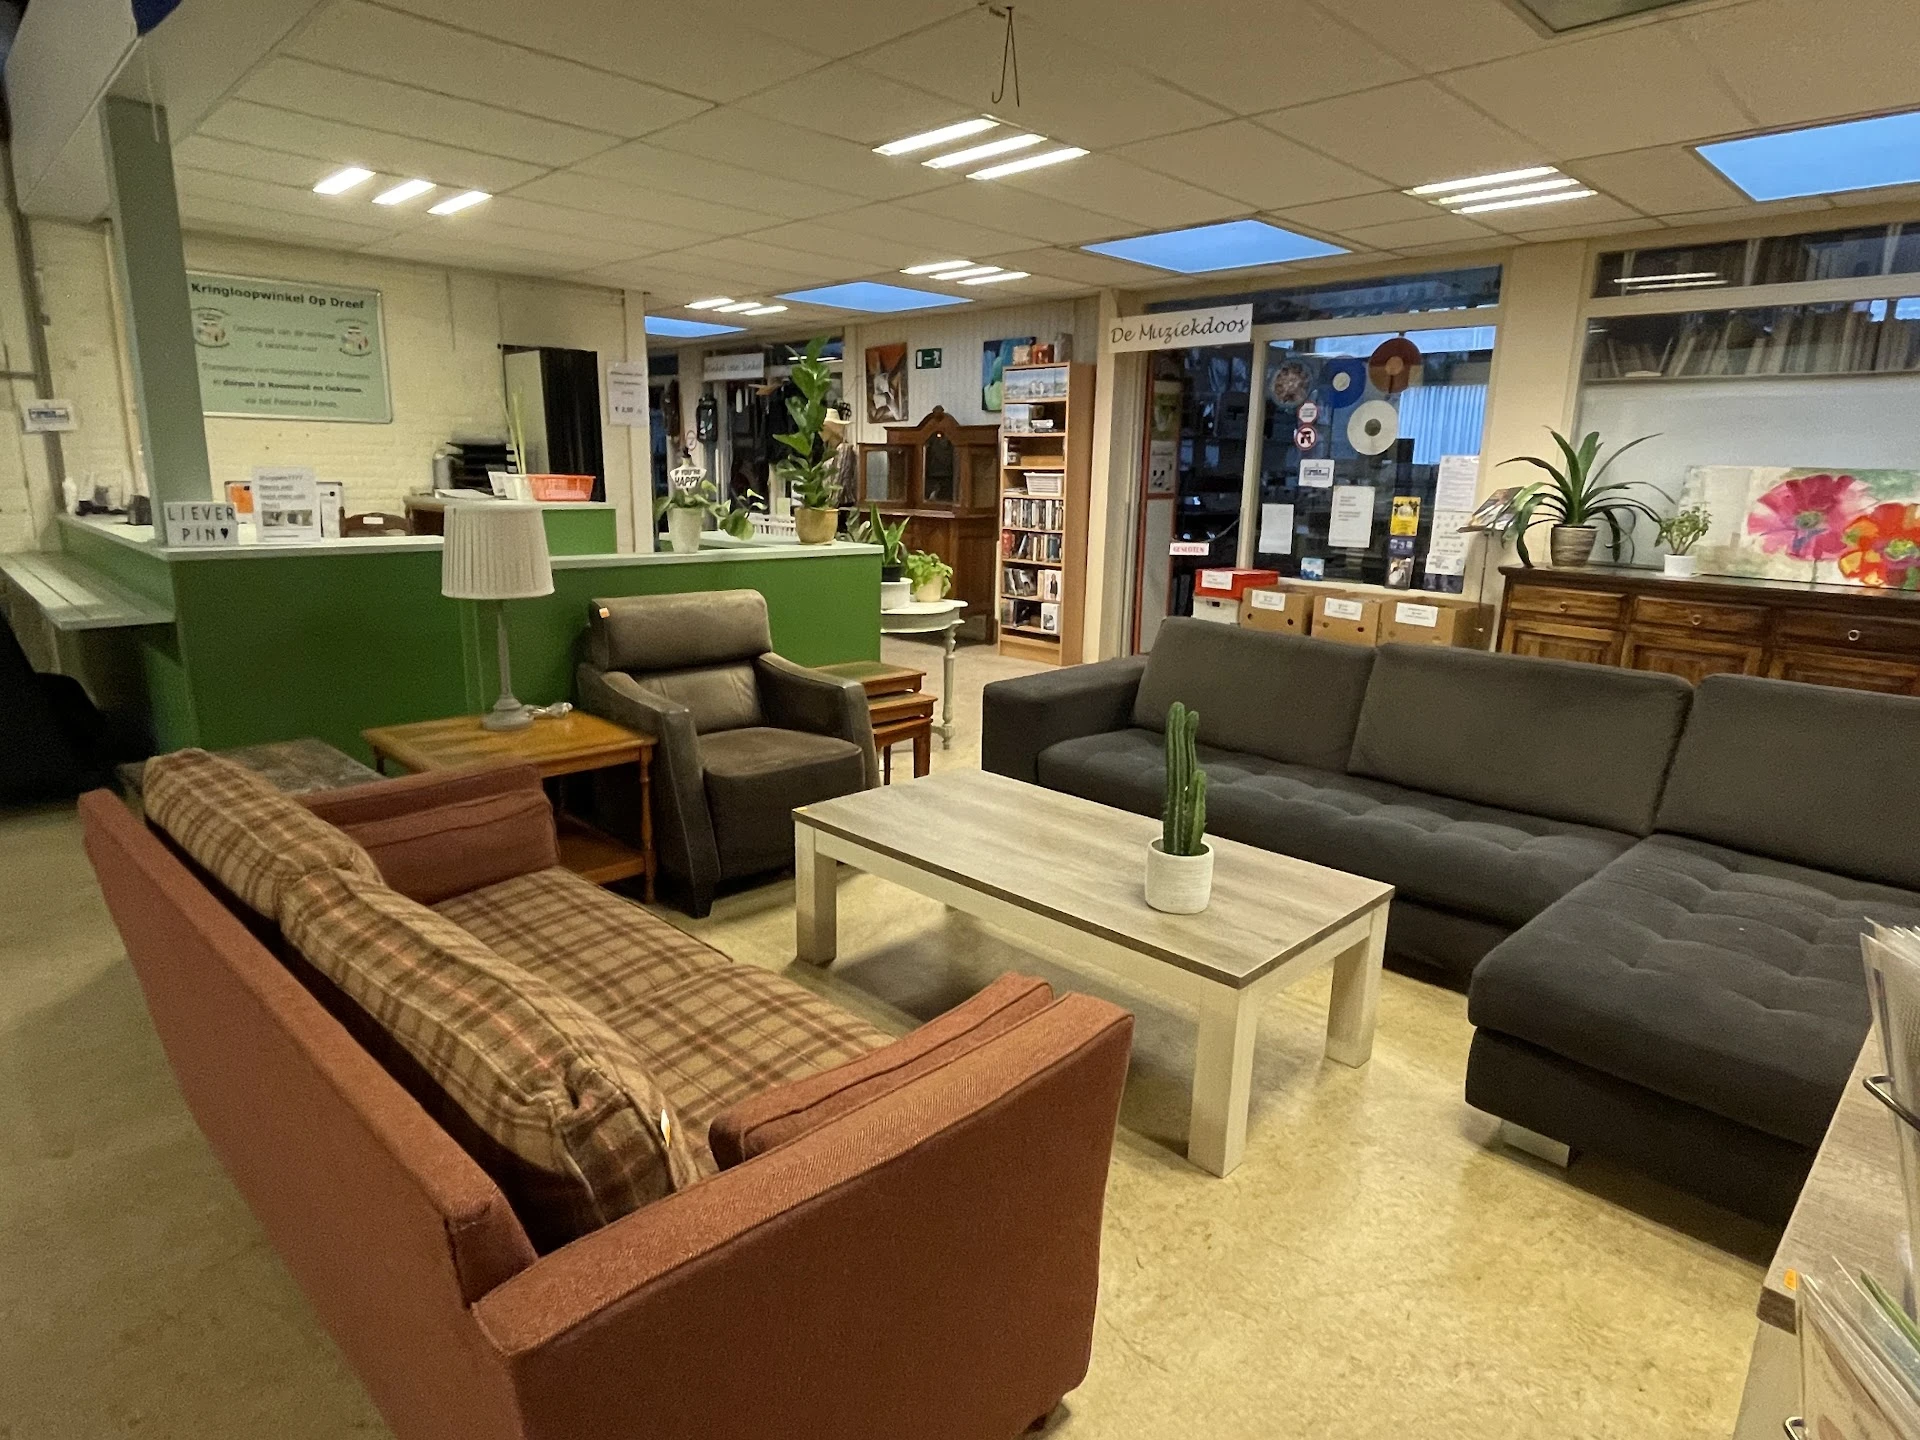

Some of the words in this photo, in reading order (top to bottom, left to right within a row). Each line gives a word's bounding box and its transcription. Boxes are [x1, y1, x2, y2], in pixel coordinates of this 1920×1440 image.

[191, 283, 304, 303] Kringloopwinkel
[308, 295, 326, 307] Op
[330, 297, 364, 309] Dreef
[1111, 327, 1135, 343] De
[1140, 317, 1249, 344] Muziekdoos
[674, 476, 701, 487] HAPPY
[167, 506, 236, 521] LIEVER
[182, 527, 216, 541] PIN
